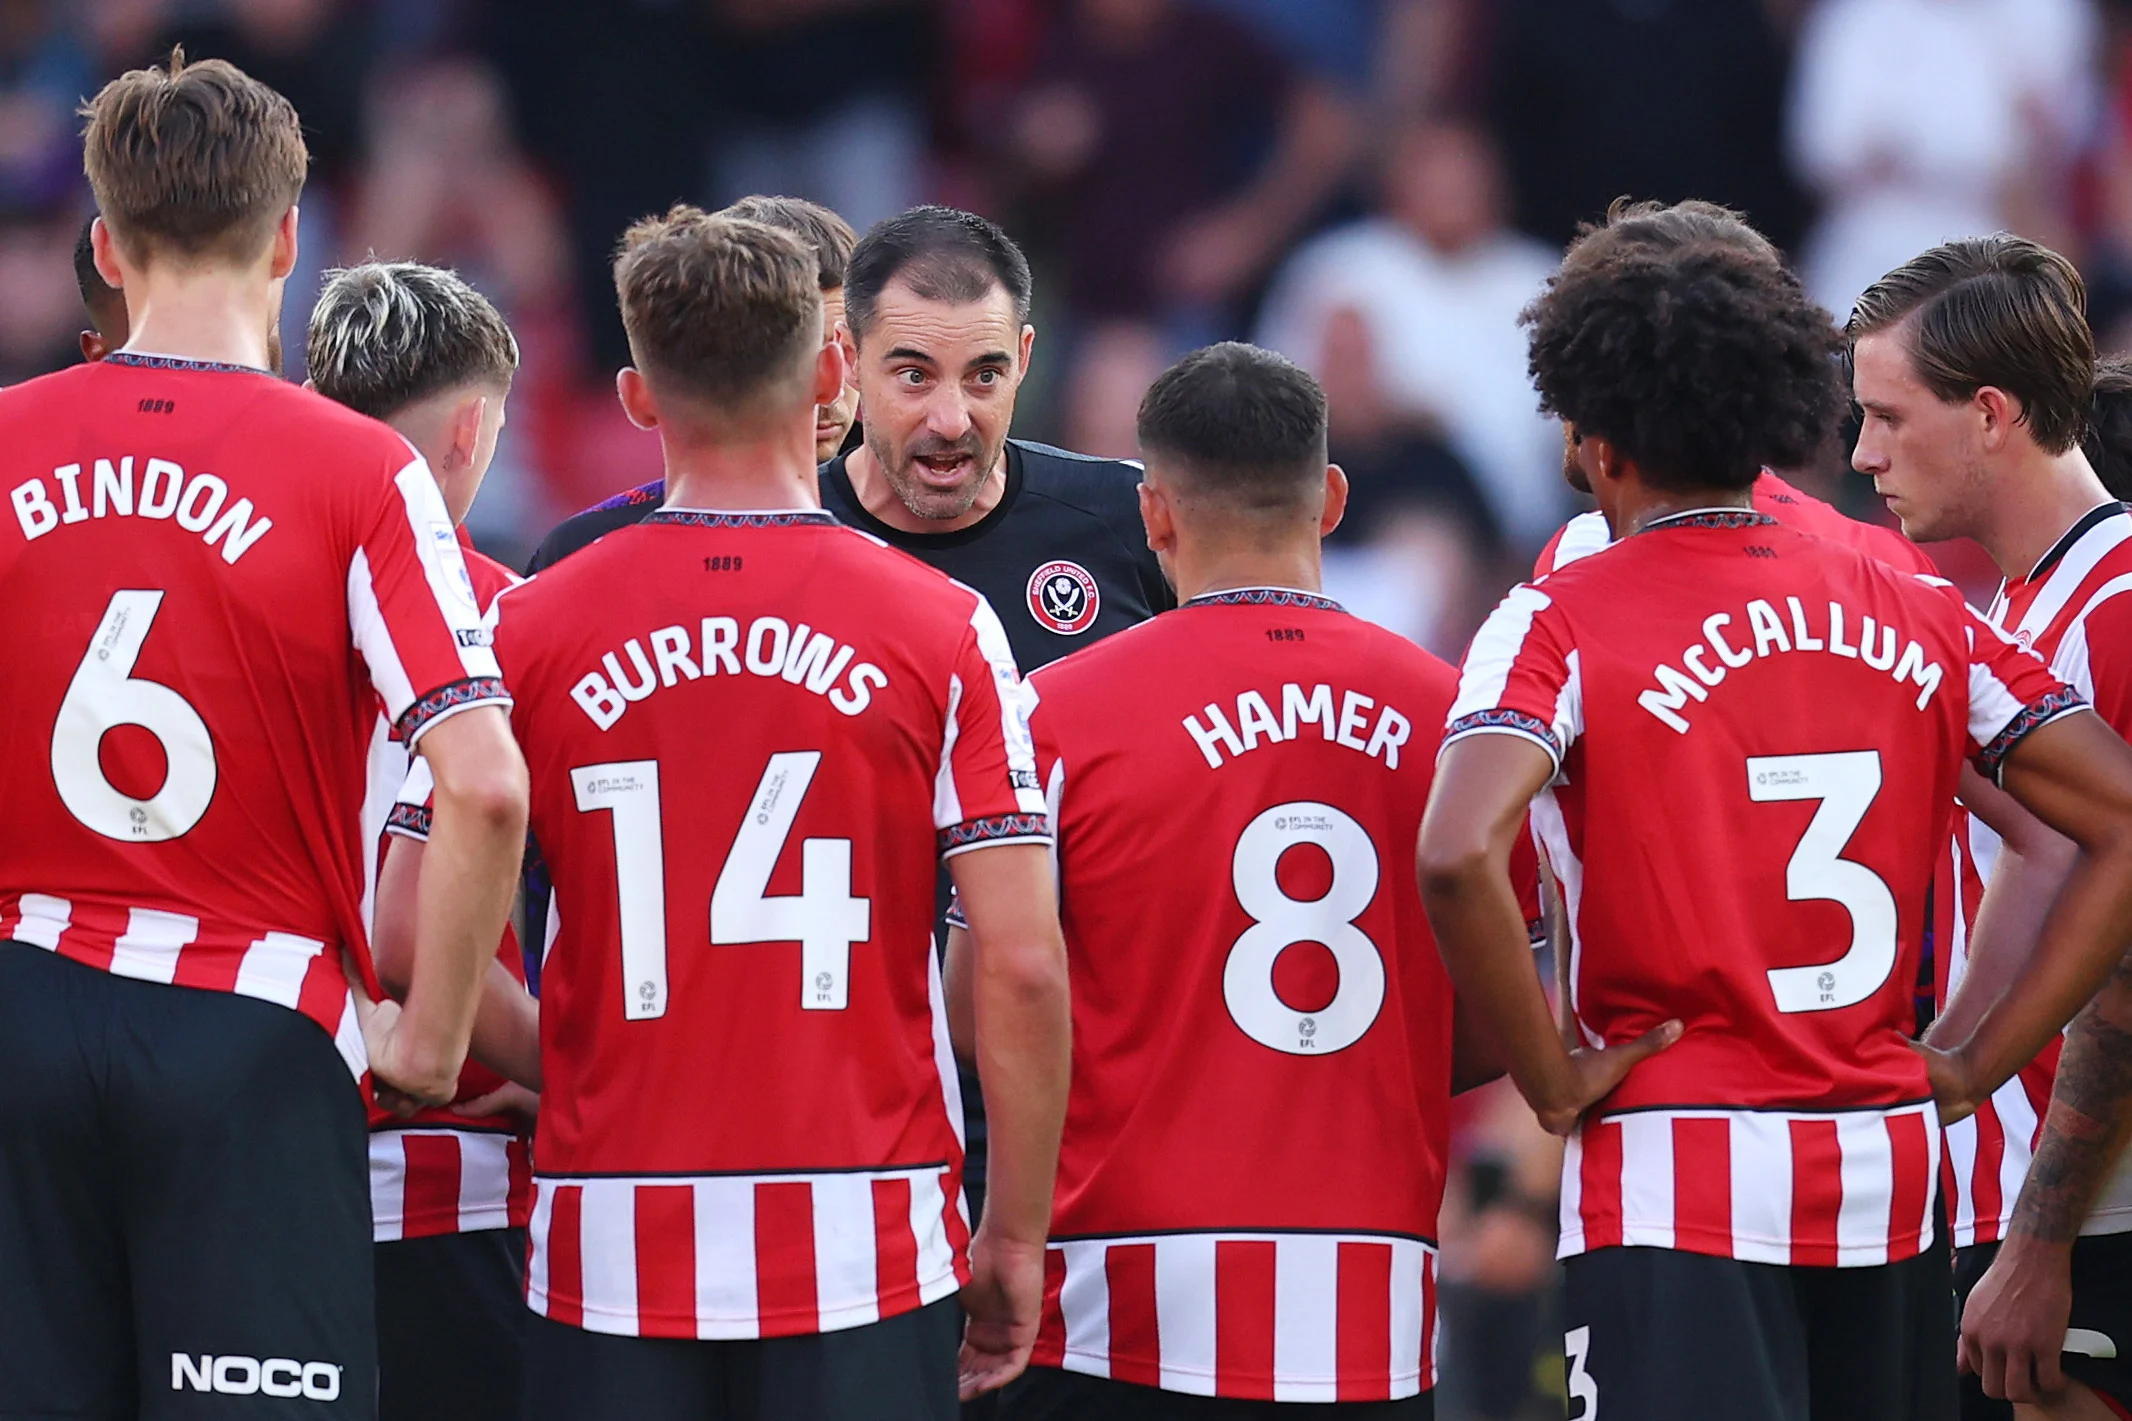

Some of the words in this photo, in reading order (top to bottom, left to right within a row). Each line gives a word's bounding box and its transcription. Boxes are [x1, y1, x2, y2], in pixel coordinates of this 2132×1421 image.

[10, 456, 273, 565] BINDON
[703, 556, 743, 571] 1889
[1032, 565, 1061, 596] SHEFFIELD
[1063, 566, 1090, 585] UNITED
[569, 616, 889, 732] BURROWS
[1265, 628, 1305, 642] 1889
[51, 589, 217, 843] 6
[1182, 683, 1412, 770] HAMER
[569, 750, 871, 1021] 14
[1222, 801, 1386, 1056] 8
[1745, 749, 1898, 1014] 3
[171, 1352, 341, 1401] NOCO
[1564, 1325, 1598, 1421] 3
